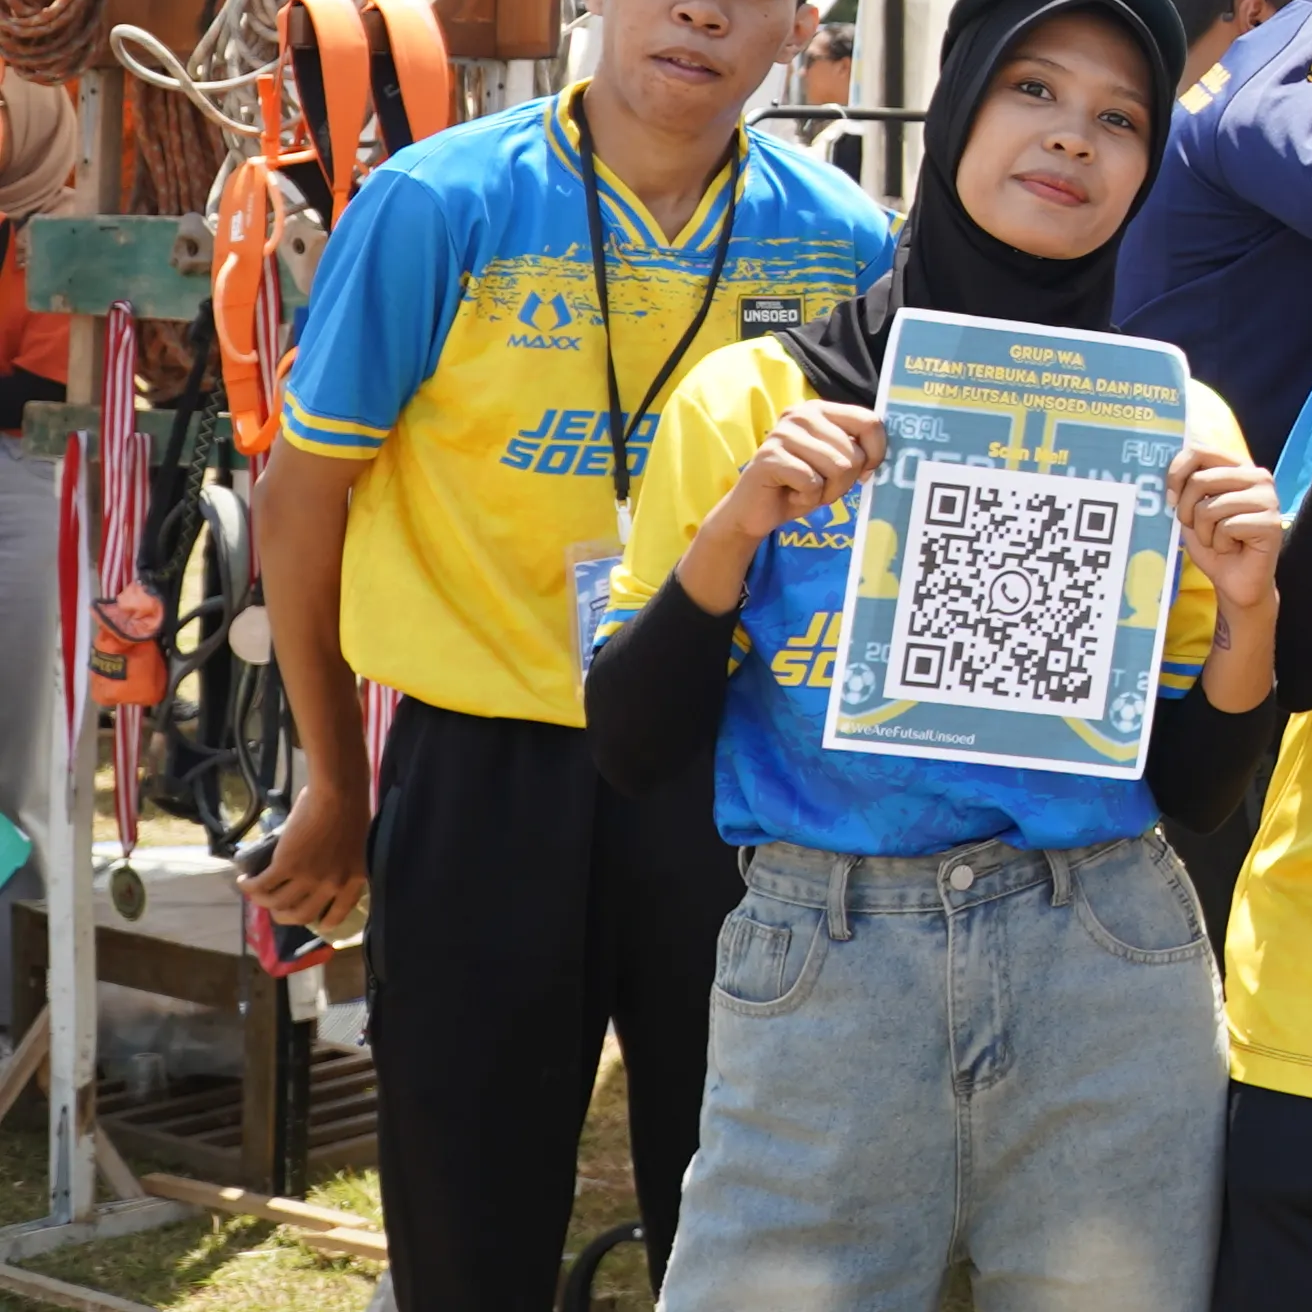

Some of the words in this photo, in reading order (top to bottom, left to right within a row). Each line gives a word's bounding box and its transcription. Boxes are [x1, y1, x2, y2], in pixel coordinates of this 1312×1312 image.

[743, 308, 798, 323] UNSOED
[507, 334, 582, 351] MAXX
[1009, 344, 1054, 366] GRUP
[1057, 349, 1085, 368] WA
[904, 355, 962, 378] LATIAN
[967, 362, 1039, 387] TERBUKA
[1041, 371, 1093, 392] PUTRA
[1095, 377, 1130, 396] DAN
[1133, 382, 1179, 405] PUTRI
[923, 381, 958, 399] UKM
[961, 387, 1019, 406] FUTSAL
[1022, 393, 1088, 414] UNSOED
[1090, 401, 1154, 422] UNSOED
[518, 408, 662, 443] JEND
[888, 413, 949, 442] TSAL
[500, 438, 651, 478] SOED
[1121, 440, 1180, 468] FUT
